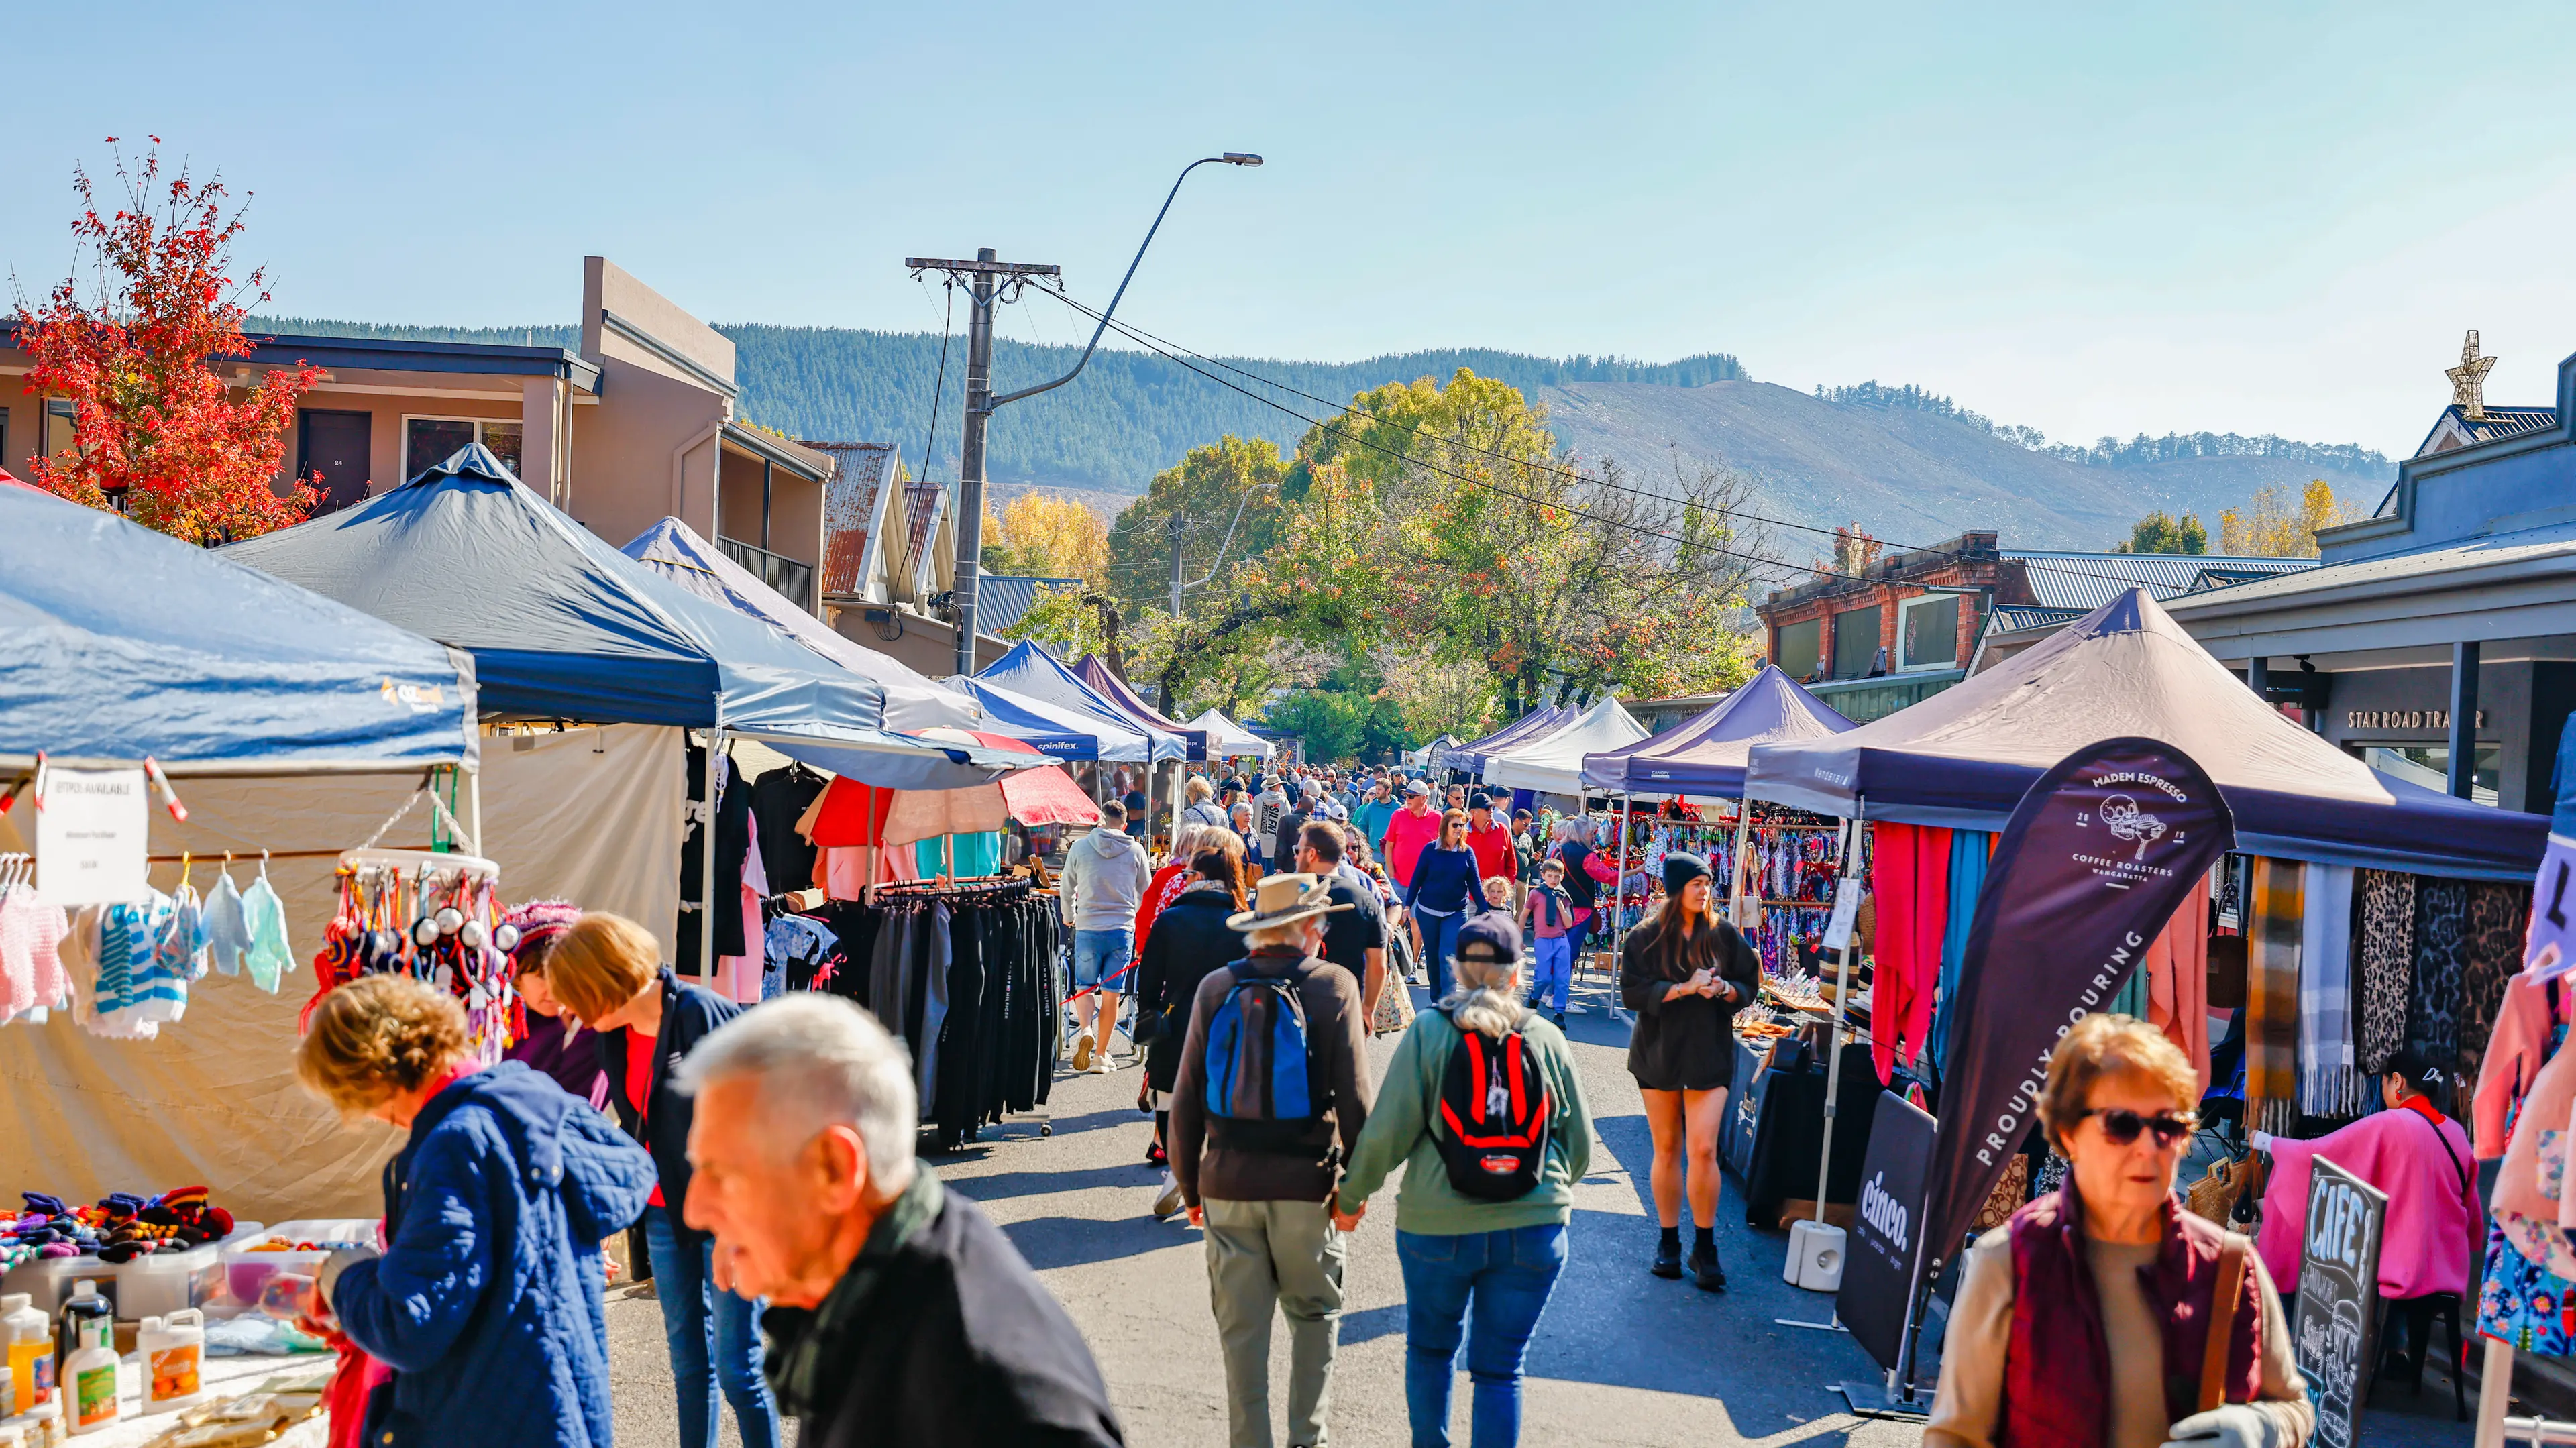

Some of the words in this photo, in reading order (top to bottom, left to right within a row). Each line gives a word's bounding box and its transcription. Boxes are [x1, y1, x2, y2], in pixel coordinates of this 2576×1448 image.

[2348, 711, 2378, 728] STAR
[2382, 711, 2420, 728] ROAD
[2425, 711, 2482, 728] TRAR
[2092, 772, 2135, 788] MADEM
[2137, 773, 2188, 803] ESPRESSO
[2072, 853, 2112, 867] COFFEE
[2116, 861, 2174, 877] ROASTERS
[1976, 1048, 2053, 1167] PROUDLY
[2056, 930, 2143, 1039] POURING
[2309, 1178, 2364, 1269] CAFE
